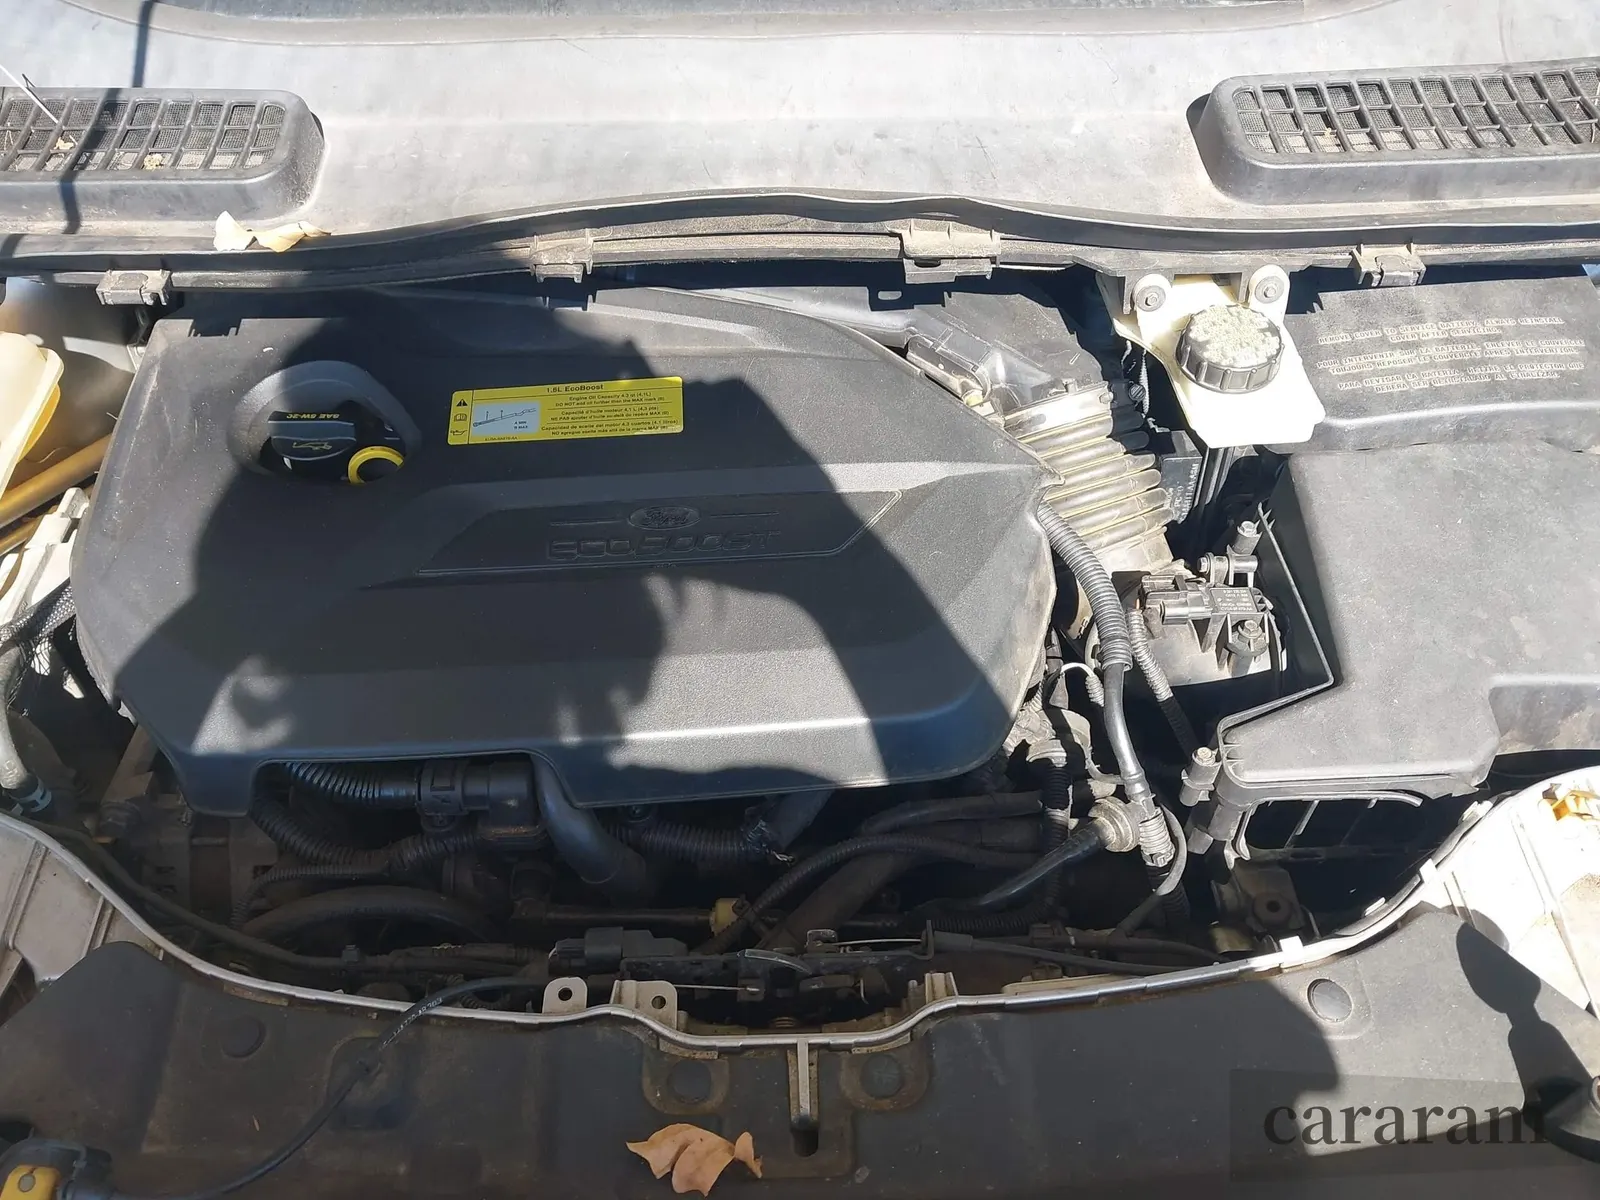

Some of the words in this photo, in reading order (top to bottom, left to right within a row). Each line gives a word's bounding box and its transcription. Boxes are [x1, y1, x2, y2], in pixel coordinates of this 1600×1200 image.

[1319, 333, 1351, 344] REMOVE
[1354, 330, 1382, 339] COVER
[1399, 323, 1437, 333] SERVICE
[1484, 318, 1516, 327] ALWAYS
[1390, 334, 1418, 343] COVER
[1420, 331, 1448, 340] AFTER
[565, 384, 604, 392] EcoBoost
[546, 531, 781, 562] ECOBOOST
